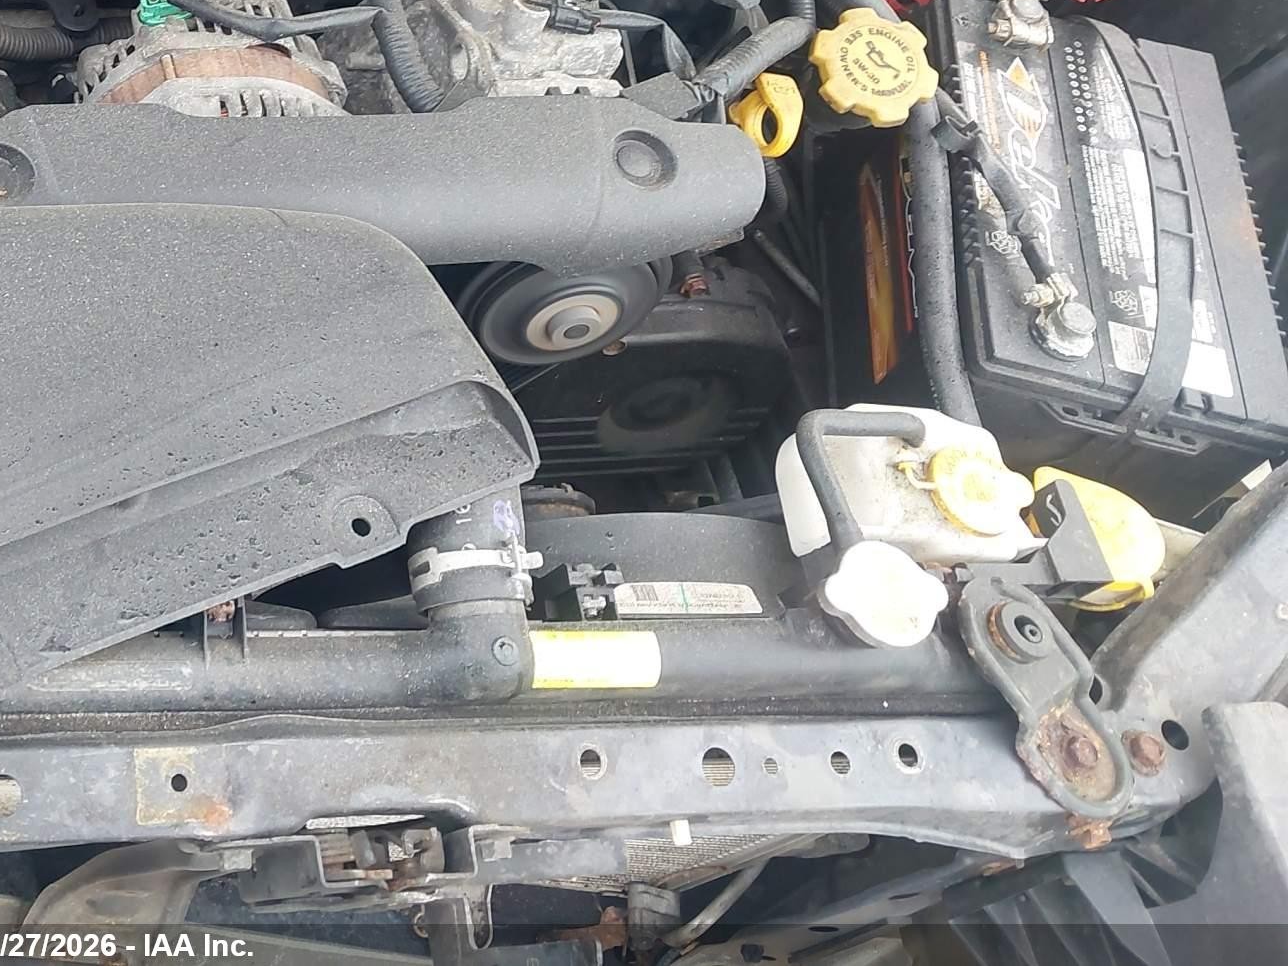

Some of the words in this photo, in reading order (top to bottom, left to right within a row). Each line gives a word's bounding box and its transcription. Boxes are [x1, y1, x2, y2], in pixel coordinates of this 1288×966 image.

[843, 29, 864, 46] SEE
[868, 27, 910, 54] ENGINE
[906, 55, 916, 73] OIL
[840, 46, 869, 91] OWNER'S
